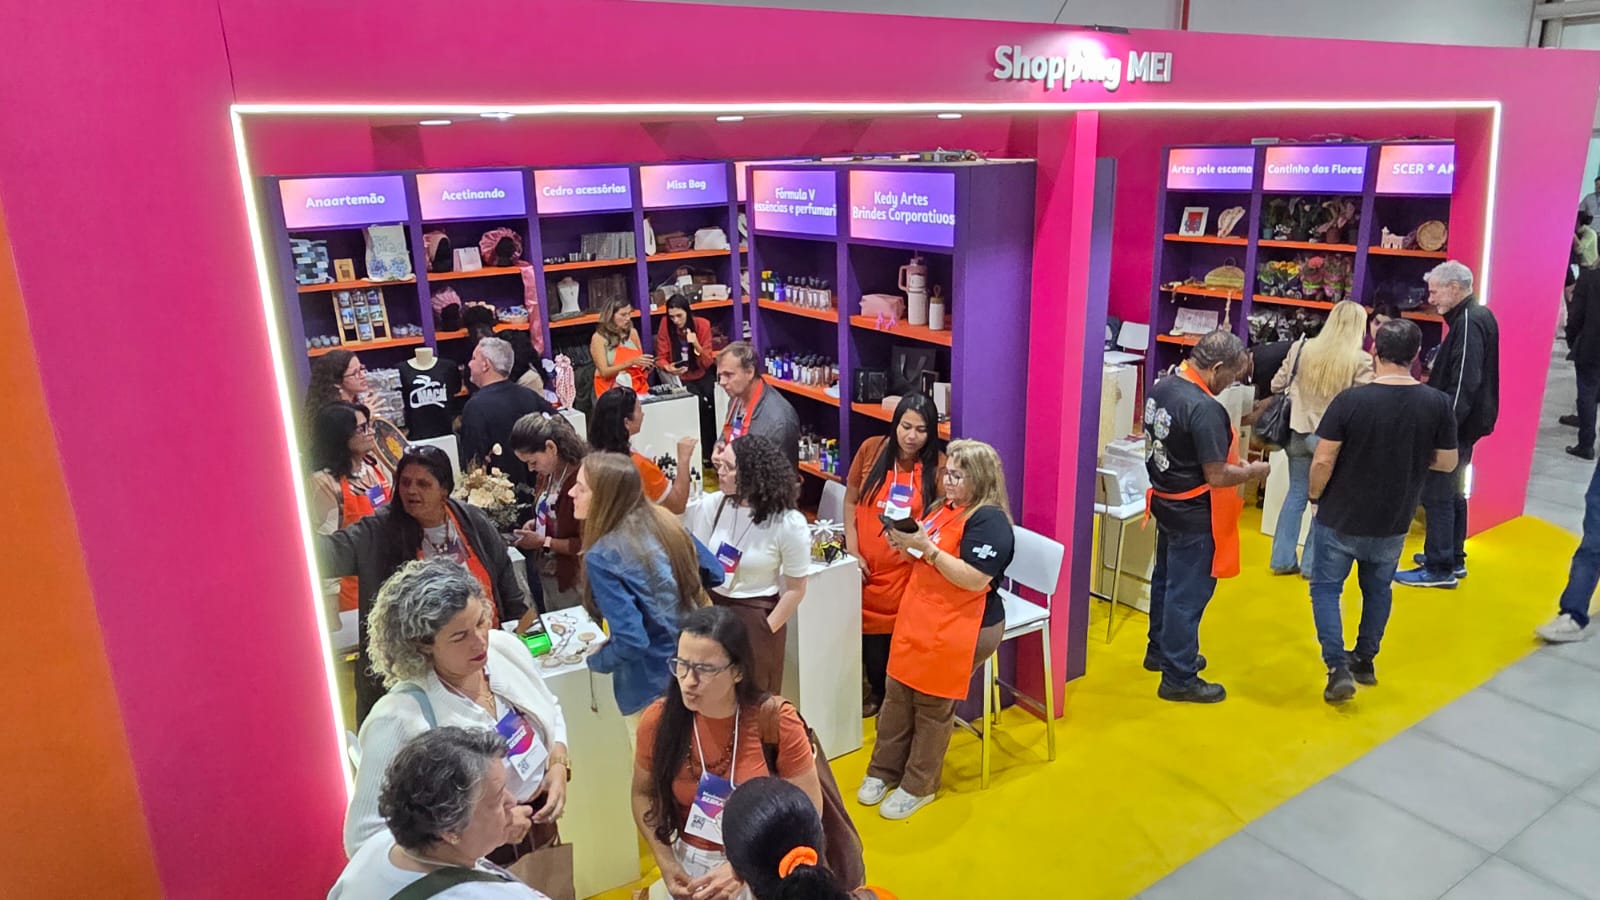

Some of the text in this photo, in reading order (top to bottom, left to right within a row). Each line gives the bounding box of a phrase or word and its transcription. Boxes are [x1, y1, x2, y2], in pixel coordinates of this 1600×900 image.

[994, 45, 1173, 91] Shopping MEI
[1171, 163, 1253, 176] Artes pele escama
[1267, 163, 1363, 175] Cantinho das Flores
[1392, 163, 1425, 175] SCER
[543, 185, 573, 197] Cedro
[666, 179, 706, 191] Miss Bag
[305, 192, 385, 208] Anaartemão
[441, 187, 505, 201] Acetinando
[775, 187, 816, 200] Fórmula V
[874, 191, 929, 206] Kedy Artes
[789, 205, 795, 214] e
[853, 207, 887, 221] Brindes
